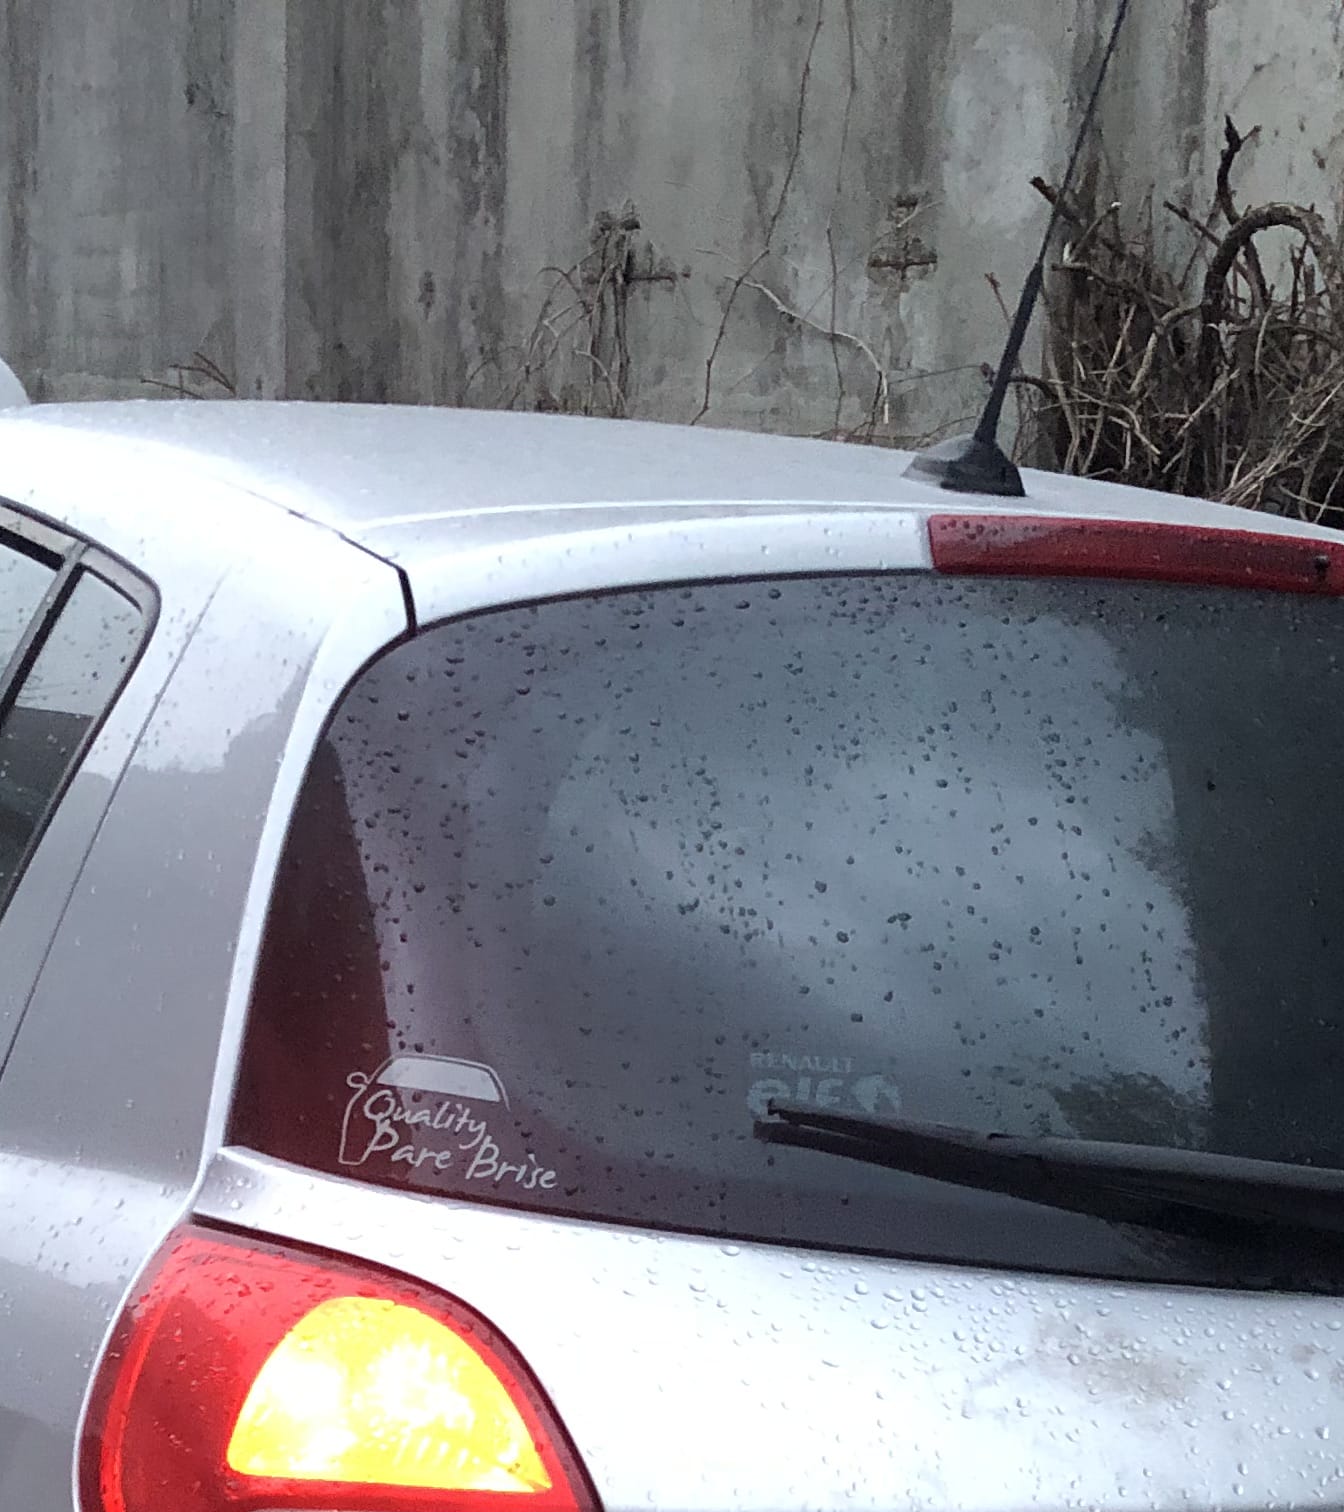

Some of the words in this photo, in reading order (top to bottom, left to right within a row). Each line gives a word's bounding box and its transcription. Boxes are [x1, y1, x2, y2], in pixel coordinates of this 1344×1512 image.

[363, 1089, 487, 1149] Quality
[361, 1117, 453, 1168] Pare
[465, 1135, 558, 1189] Brise
